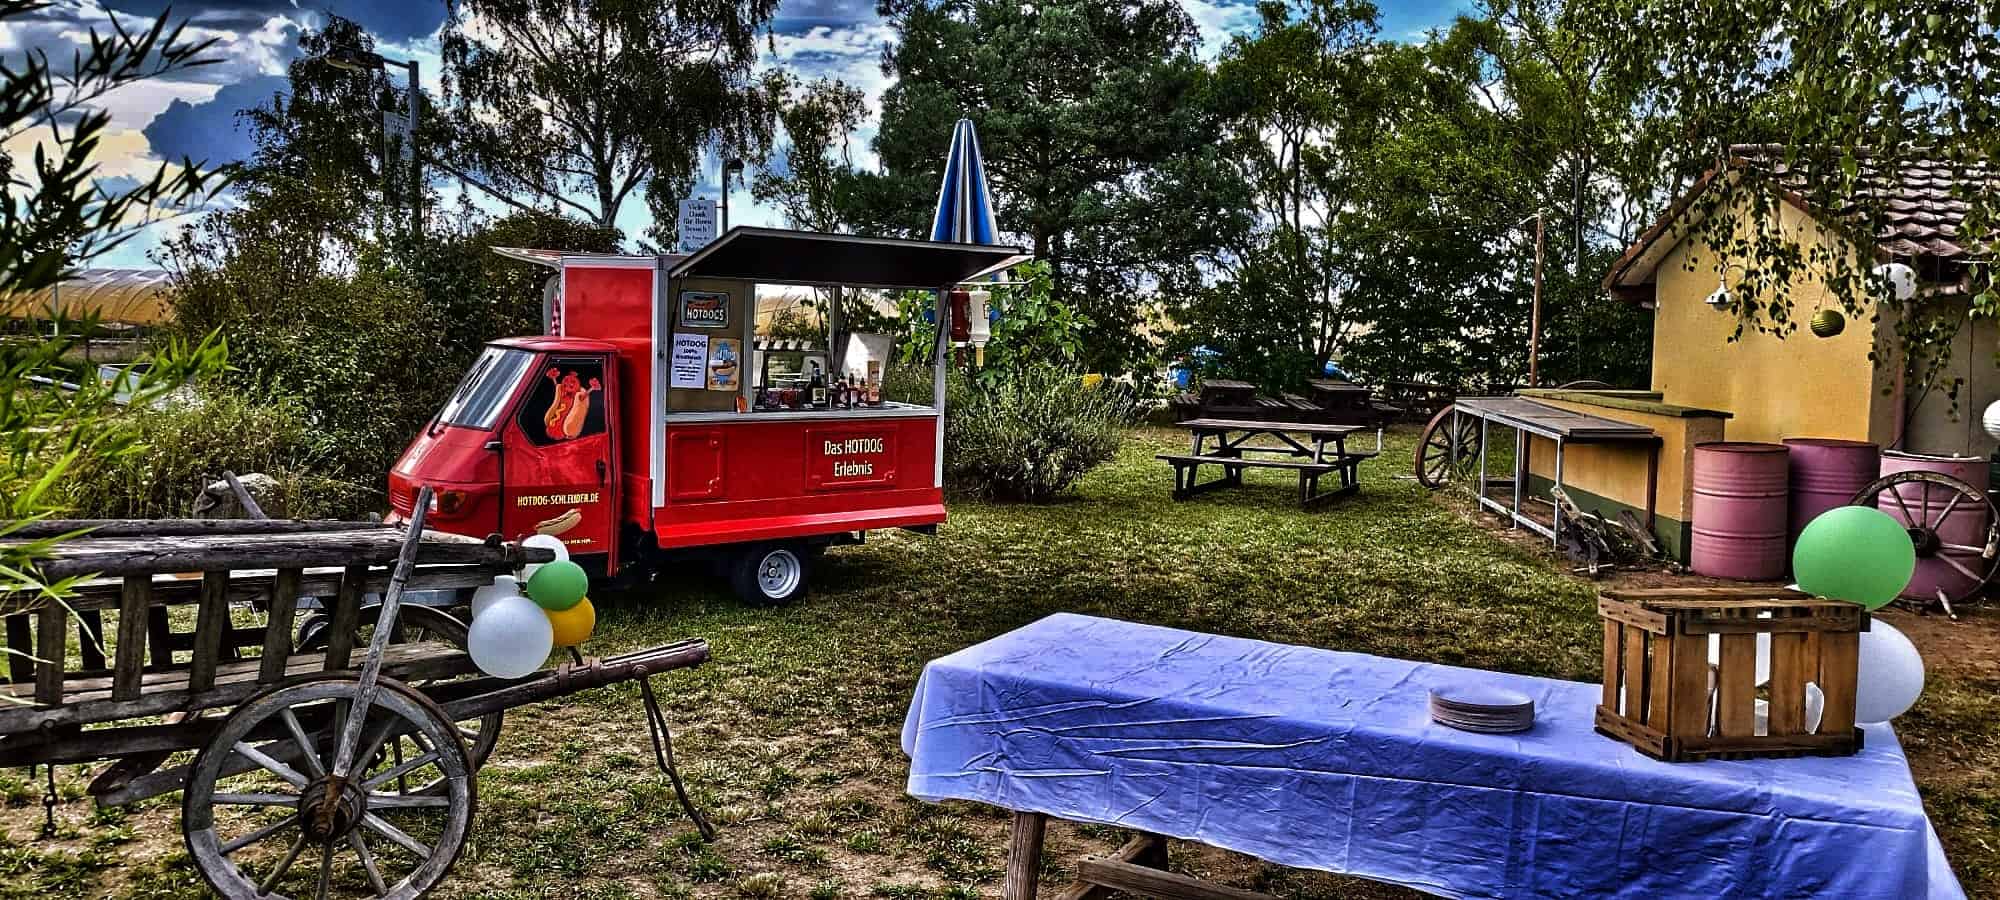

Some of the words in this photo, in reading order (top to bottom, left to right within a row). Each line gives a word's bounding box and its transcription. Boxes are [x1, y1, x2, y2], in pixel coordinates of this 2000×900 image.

[675, 340, 707, 348] HOTDOG
[824, 440, 843, 455] Das
[844, 438, 883, 454] HOTDOG
[834, 460, 873, 477] Erlebnis
[517, 492, 600, 507] HOTDOG-SCHLEUDER.DE
